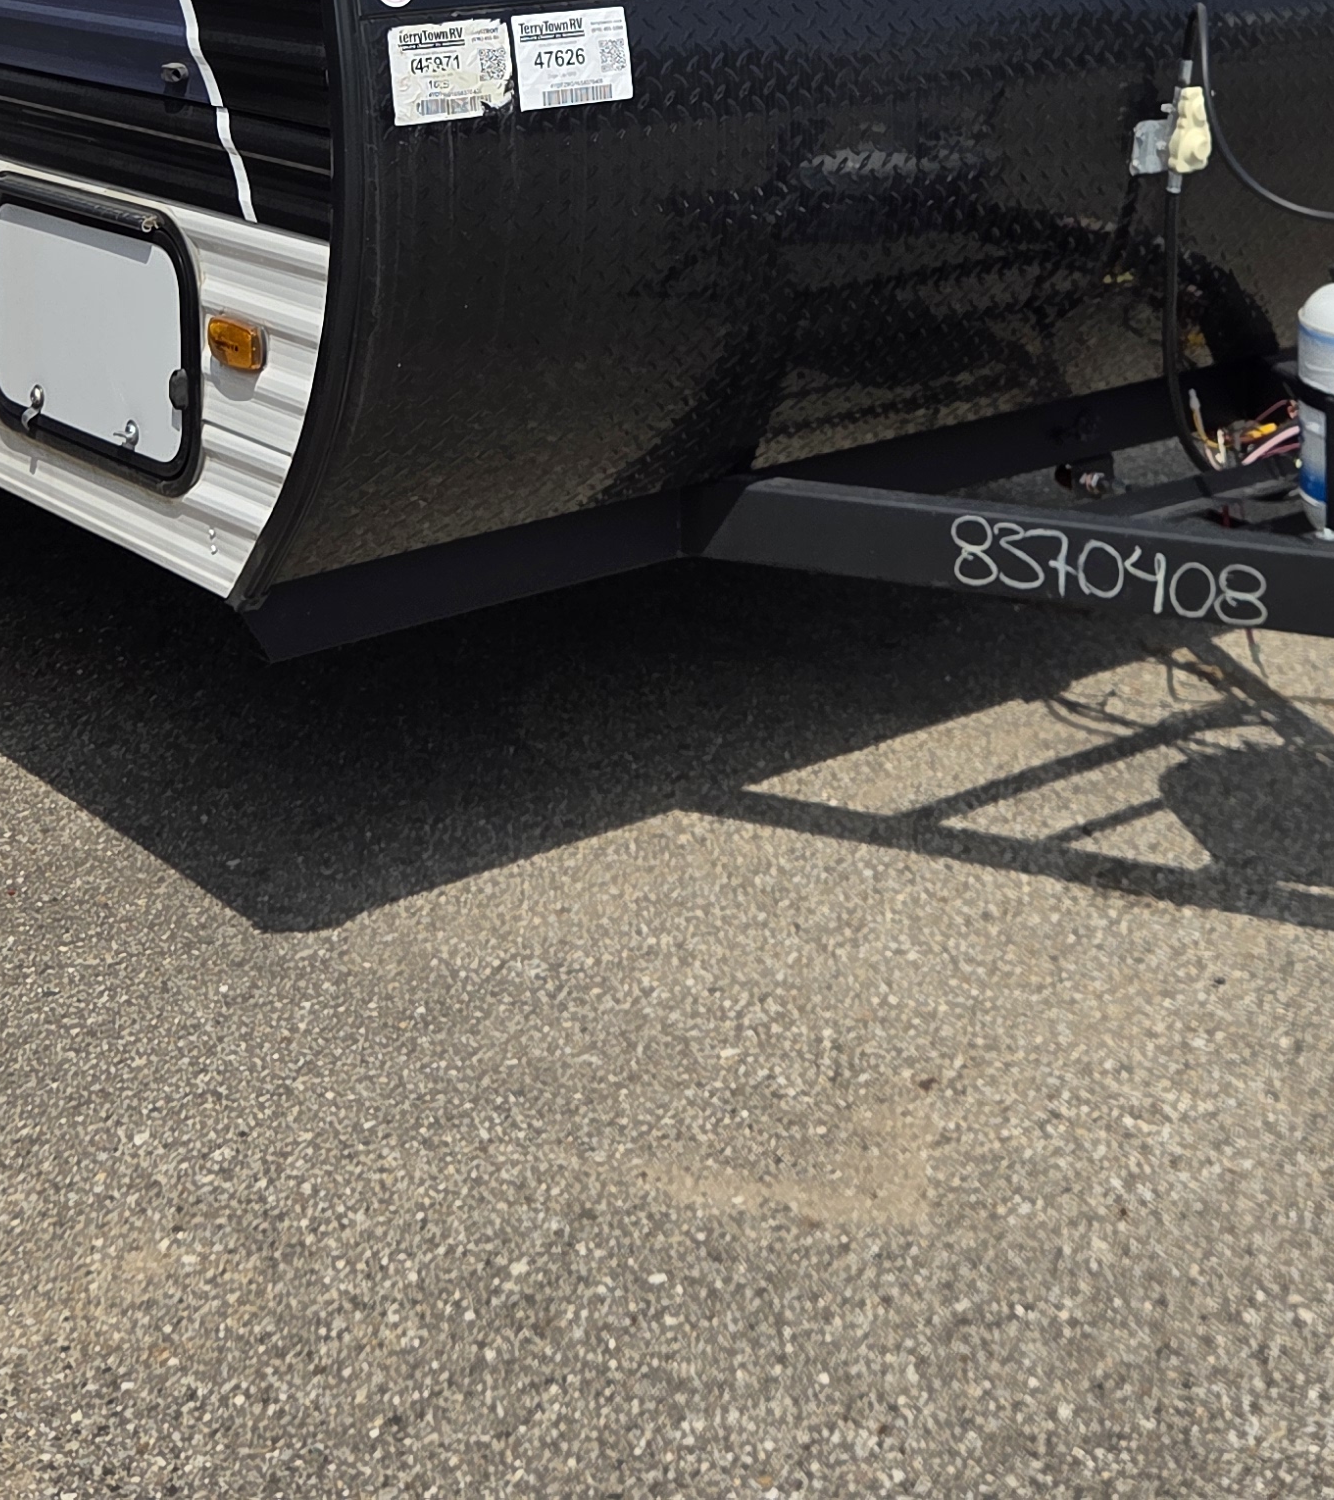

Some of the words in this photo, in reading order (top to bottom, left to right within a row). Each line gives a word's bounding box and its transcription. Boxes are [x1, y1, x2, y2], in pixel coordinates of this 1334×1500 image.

[449, 26, 463, 39] RV
[518, 21, 569, 35] TerryTown
[569, 18, 583, 30] RV
[534, 47, 586, 69] 47626
[951, 515, 1268, 625] 8370408
